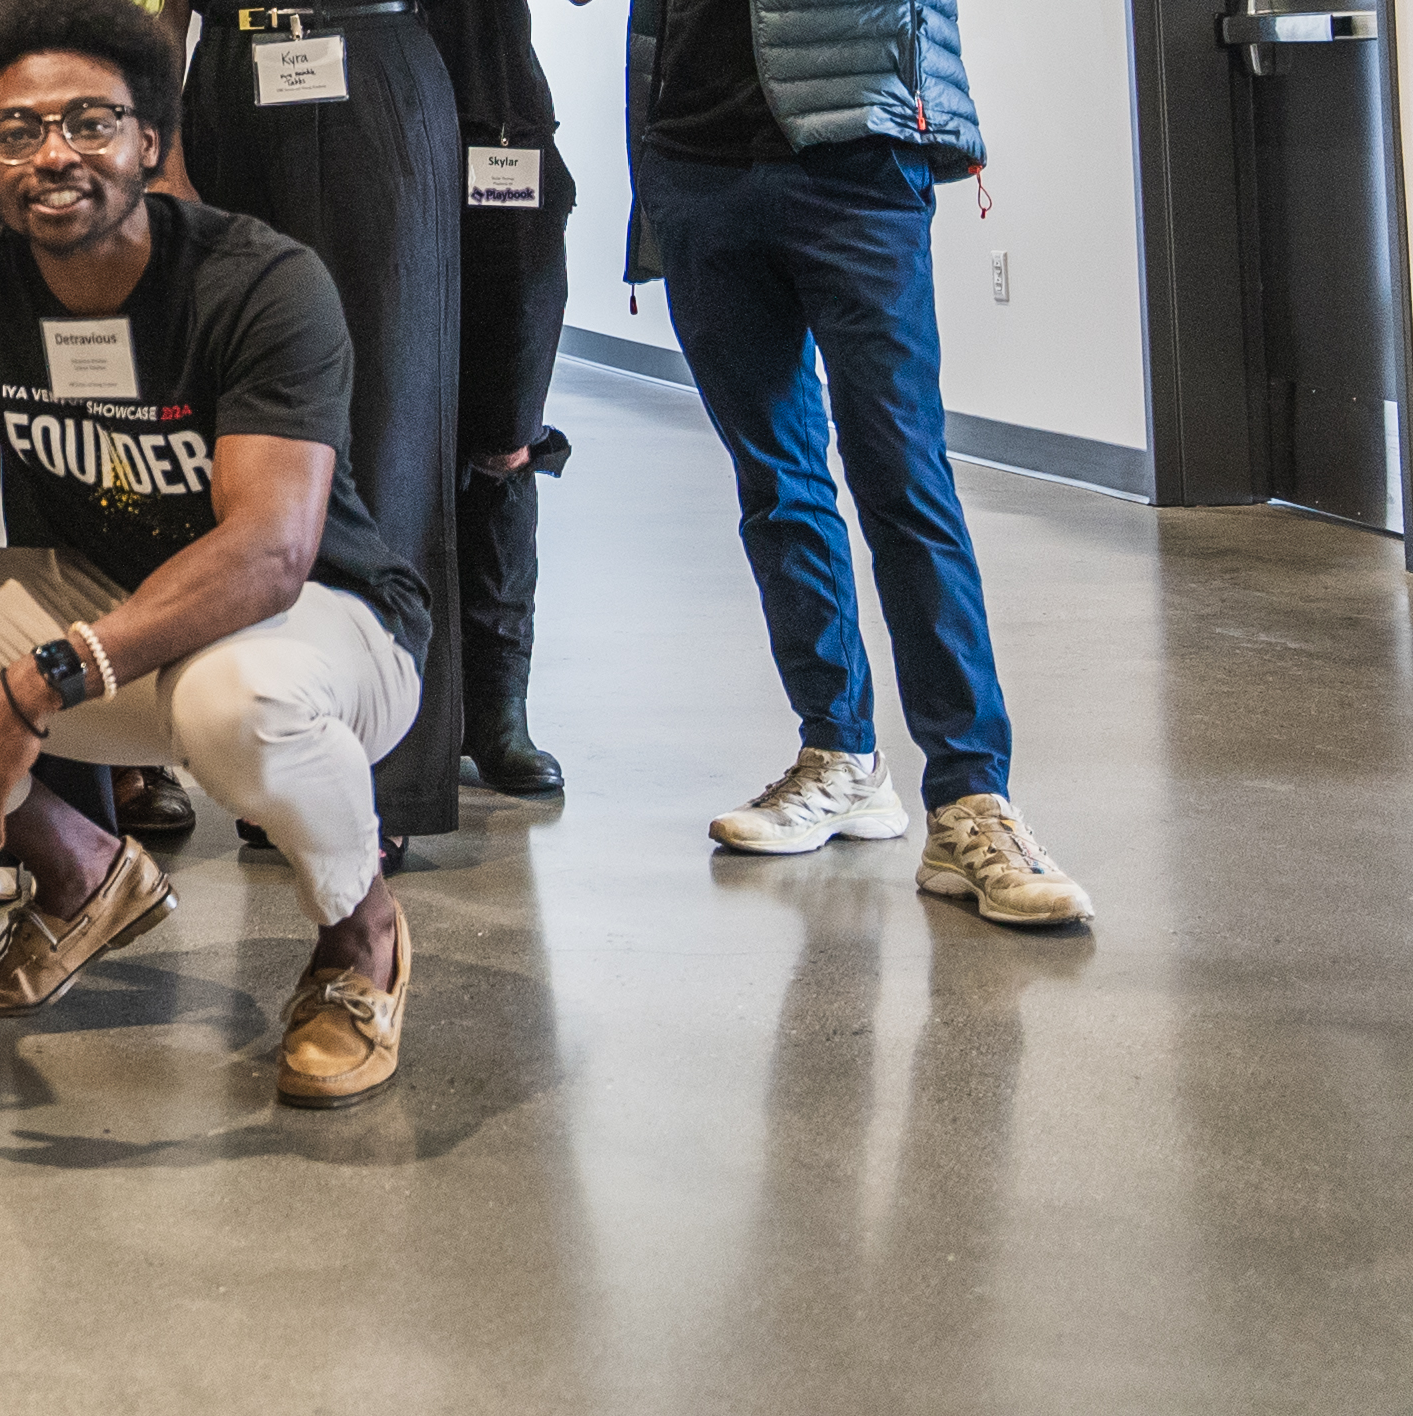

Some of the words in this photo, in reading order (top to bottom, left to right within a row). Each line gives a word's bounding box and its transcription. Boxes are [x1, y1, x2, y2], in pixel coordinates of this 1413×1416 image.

[280, 50, 309, 69] Kyra
[488, 156, 519, 168] Skylar
[484, 186, 536, 203] Playbook
[54, 332, 117, 345] Detravious
[1, 383, 28, 401] IYA
[86, 400, 158, 422] SHOWCASE
[3, 410, 213, 496] FOUNDER
